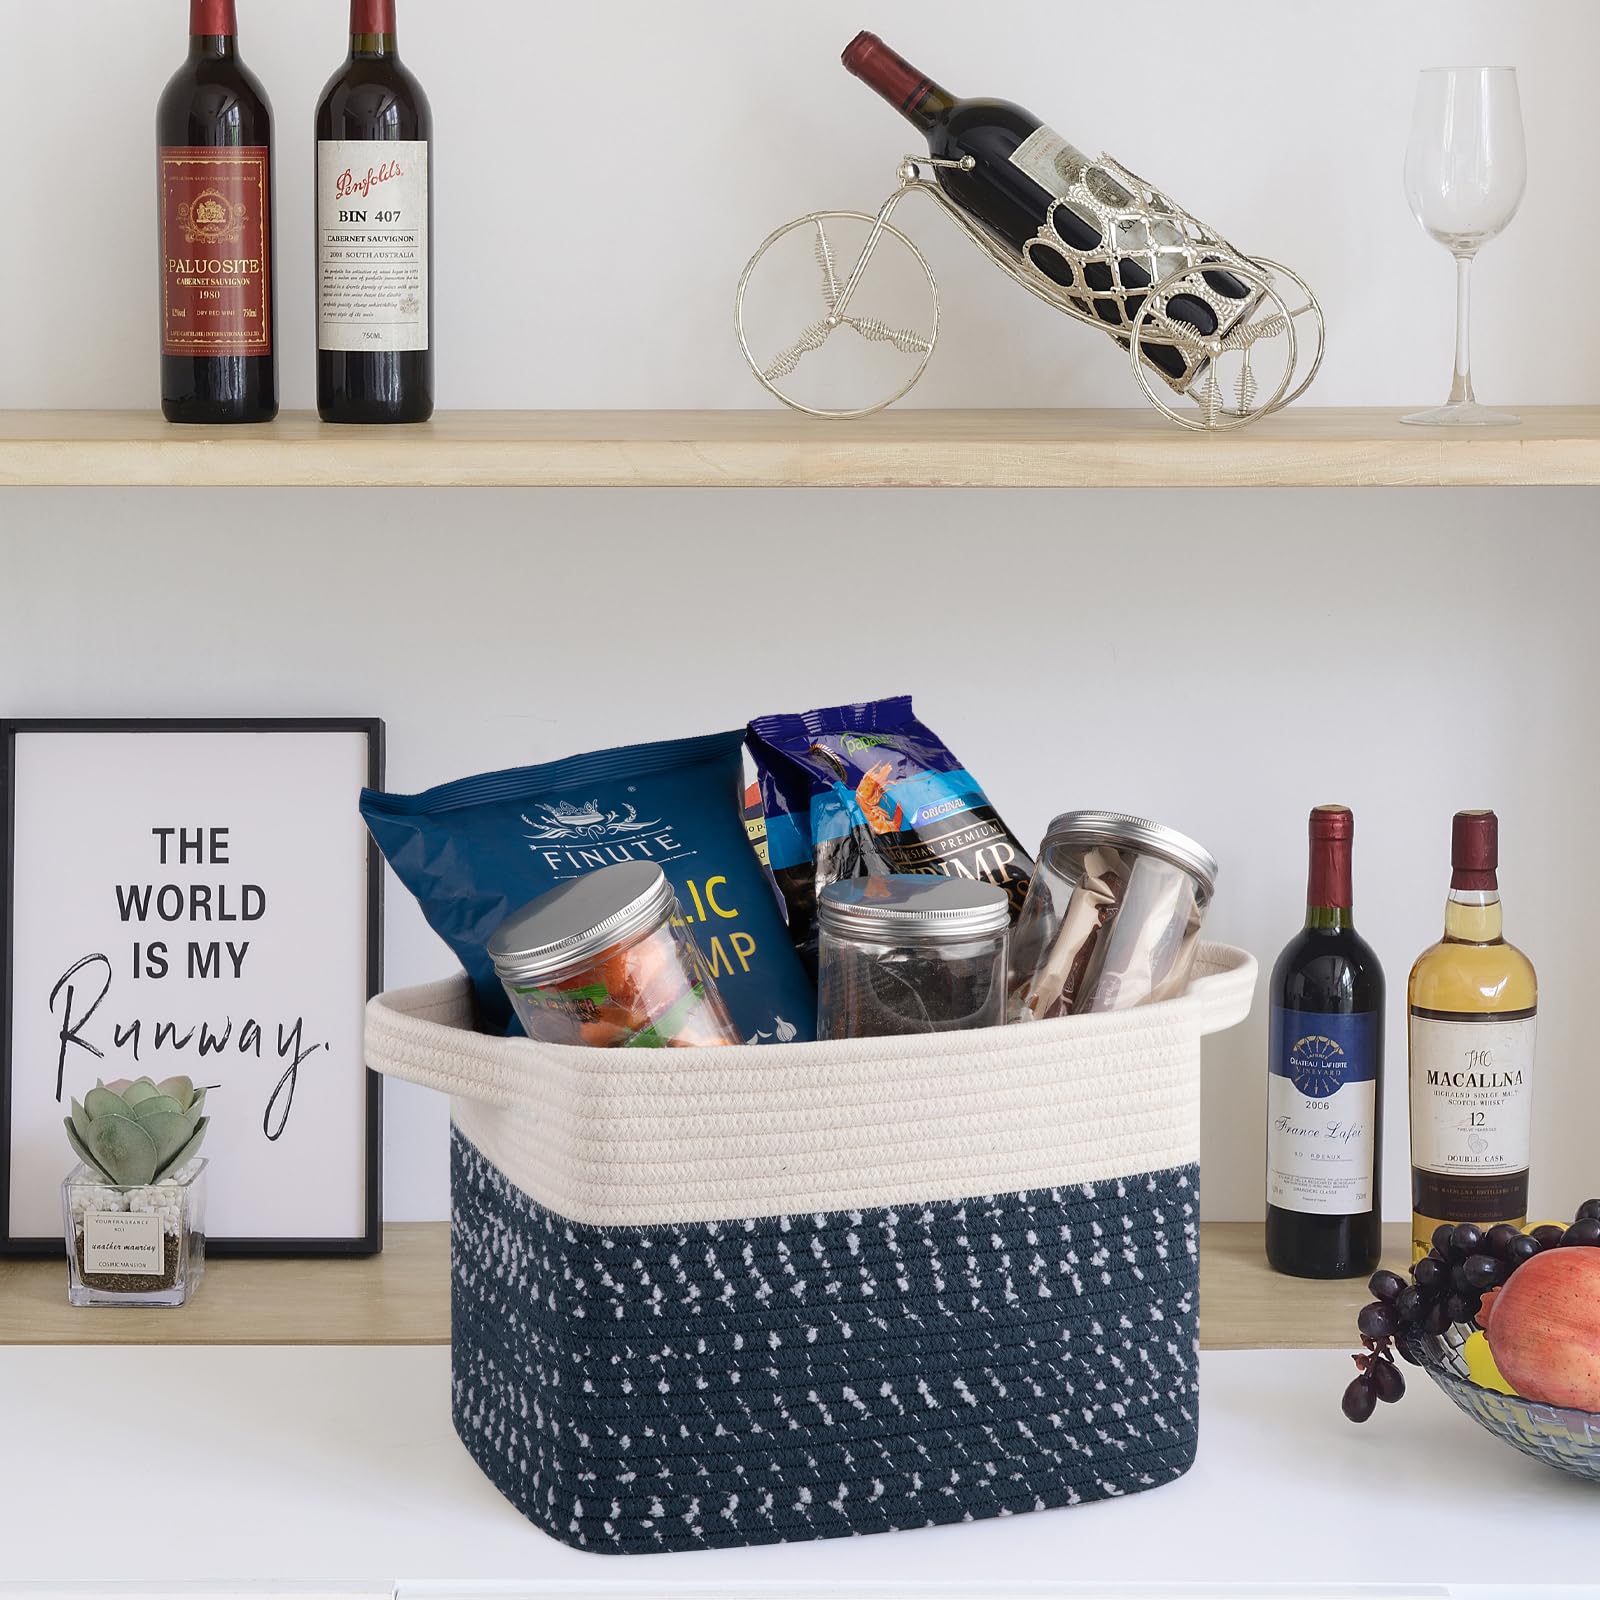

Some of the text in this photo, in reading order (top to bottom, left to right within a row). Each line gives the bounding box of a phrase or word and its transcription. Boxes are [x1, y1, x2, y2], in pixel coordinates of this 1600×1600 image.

[338, 210, 401, 222] BIN 407
[327, 235, 415, 243] CABERNET SAUVIGNON
[168, 258, 260, 274] PALUOSITE
[176, 278, 251, 286] CABERNET SAUVIGNON
[199, 290, 221, 299] 1980
[921, 799, 966, 820] ORIGINAL
[151, 827, 230, 864] THE
[940, 824, 1001, 851] PREMIUM
[542, 833, 682, 871] FINUTE
[115, 884, 267, 922] WORLD
[132, 941, 250, 980] IS MY
[49, 952, 331, 1142] Runway.
[1426, 1069, 1523, 1088] MACALLNA
[1305, 1100, 1330, 1110] 2006
[1274, 1115, 1320, 1138] France
[1471, 1111, 1485, 1126] 12
